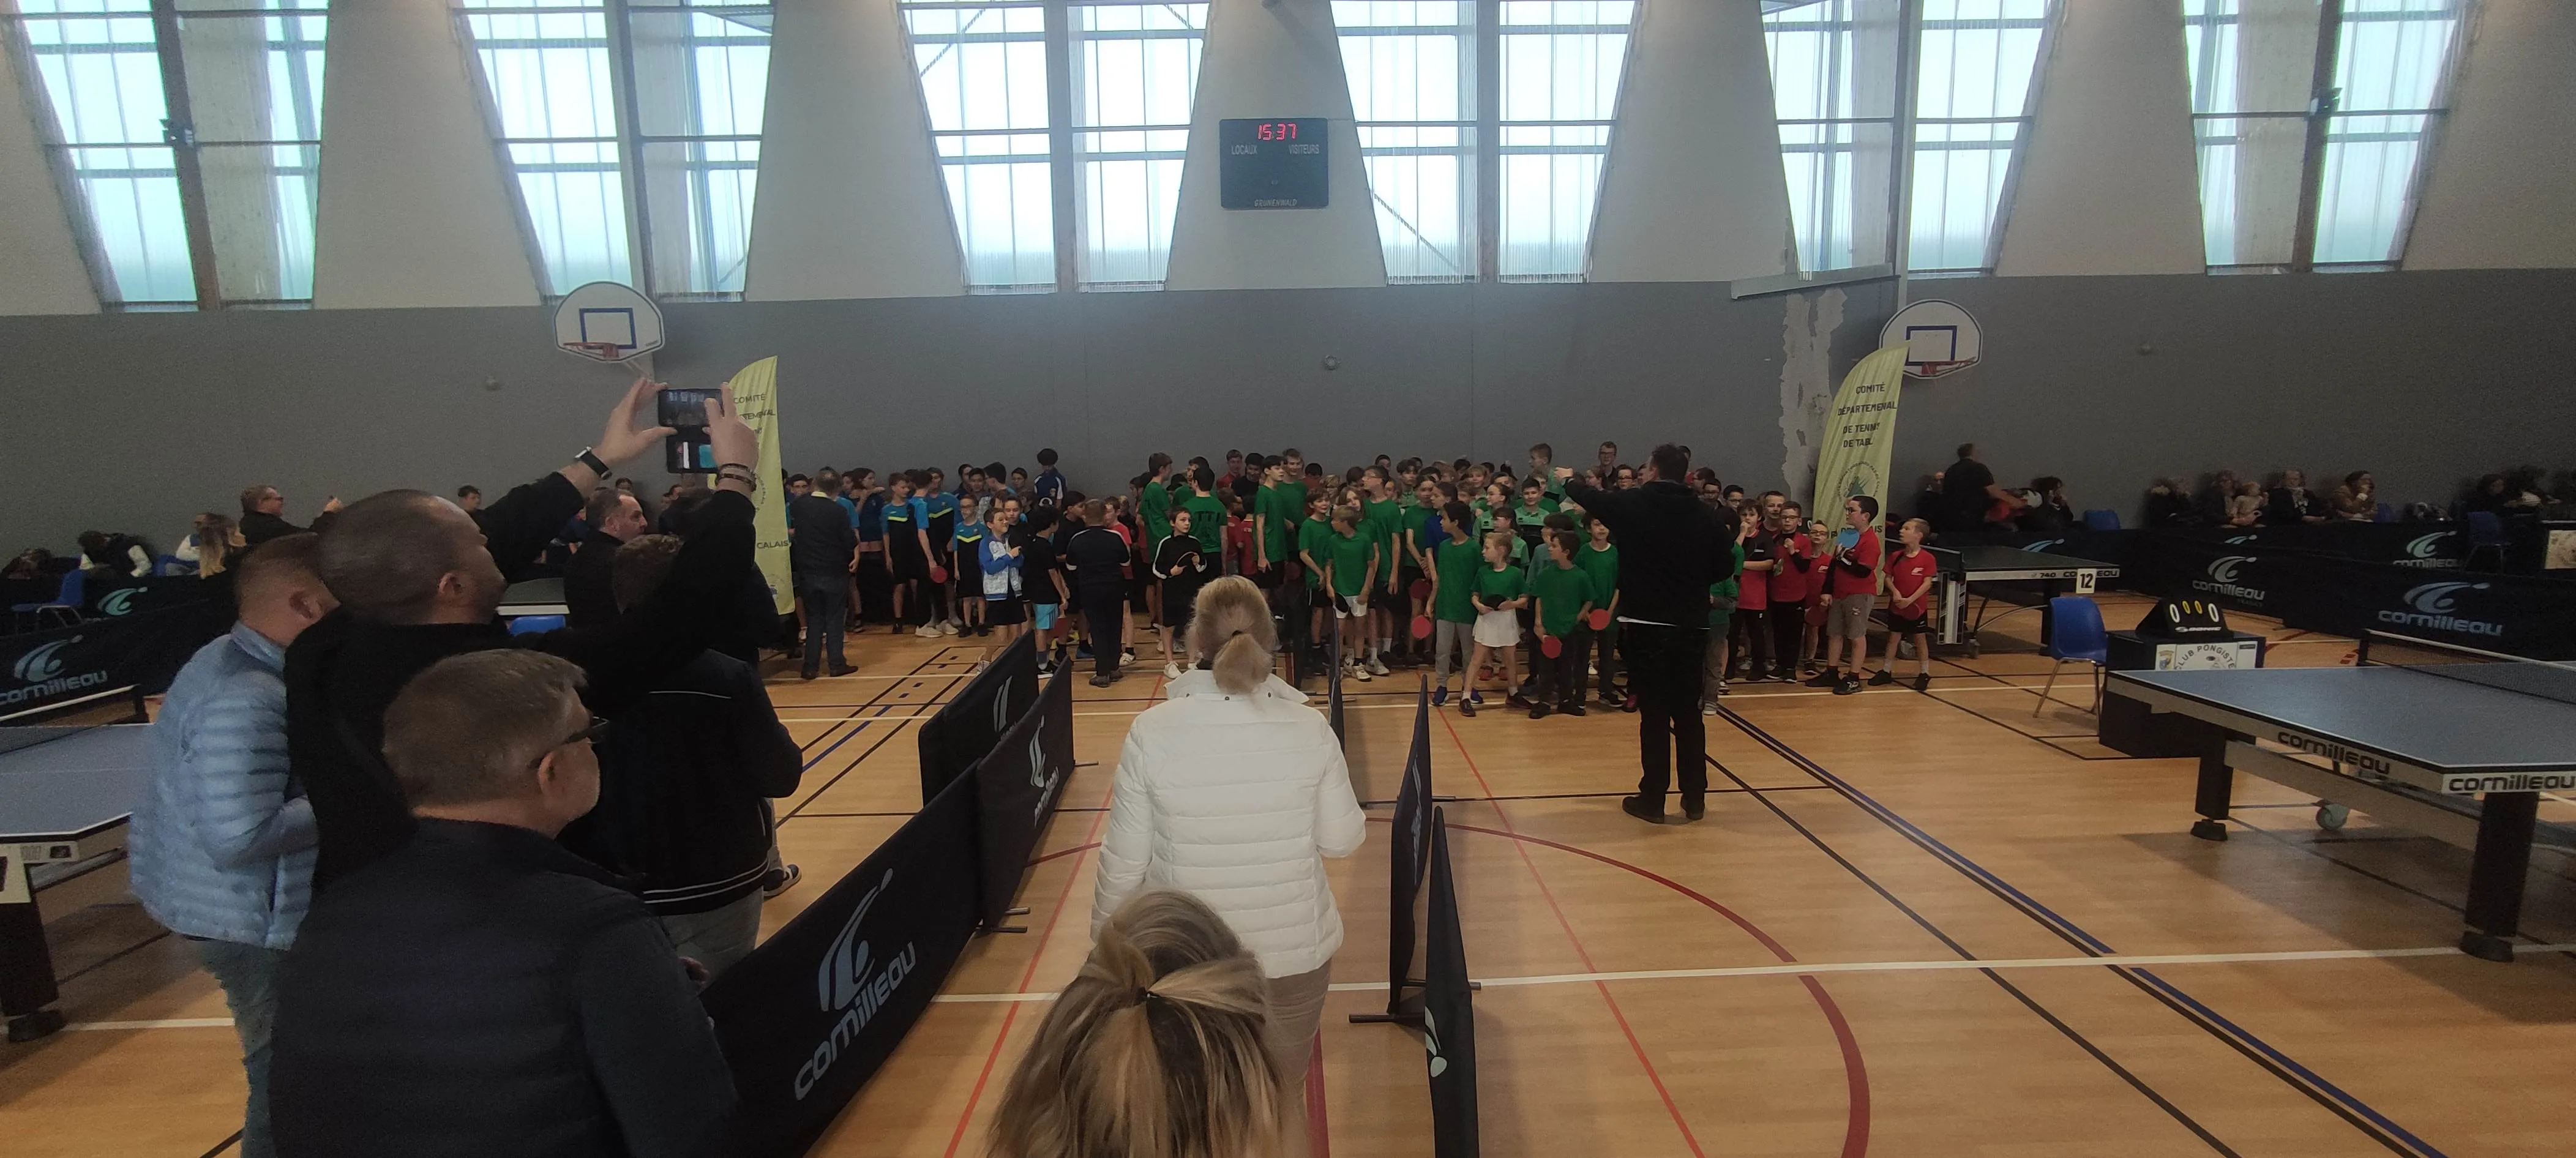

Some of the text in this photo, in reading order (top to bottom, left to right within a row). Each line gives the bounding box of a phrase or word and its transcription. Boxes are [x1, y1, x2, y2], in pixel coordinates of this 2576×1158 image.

[1231, 144, 1320, 155] LOCAUX VISITEURS
[1855, 382, 1885, 394] COMITÉ
[734, 394, 766, 404] COMITÉ
[1843, 425, 1853, 435] DE
[1843, 439, 1854, 448] DE
[757, 540, 789, 549] CALAIS
[2080, 573, 2094, 588] 12
[2170, 603, 2180, 623] 0
[2182, 600, 2190, 614] 0
[2194, 600, 2203, 614] 0
[2208, 603, 2219, 622] 0
[2378, 610, 2503, 637] cornilleau
[2174, 644, 2235, 670] CLUB PONGISTE
[2277, 731, 2390, 775] cornilleau
[2448, 775, 2575, 791] cornilleau
[795, 941, 916, 1100] cornilleau
